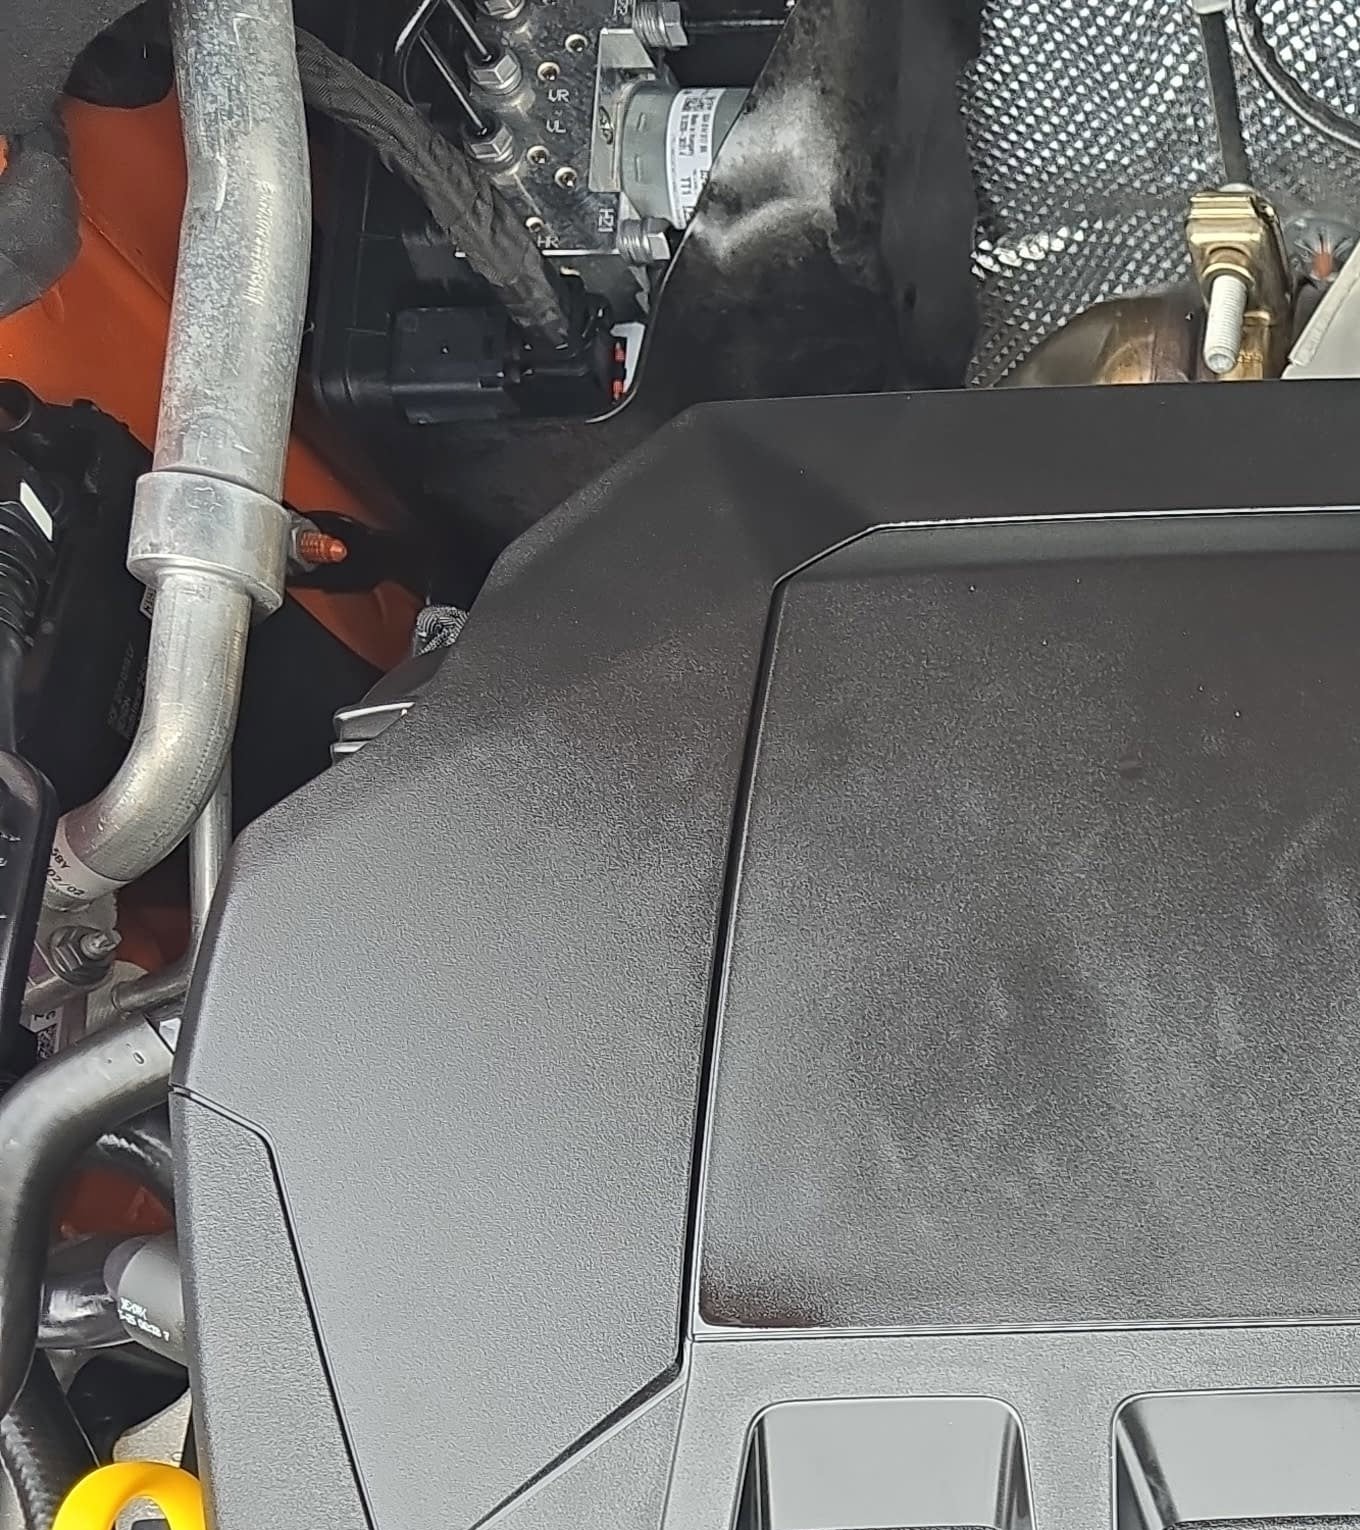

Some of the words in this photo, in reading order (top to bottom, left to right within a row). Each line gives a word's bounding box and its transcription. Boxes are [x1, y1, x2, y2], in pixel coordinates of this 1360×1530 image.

[548, 89, 570, 102] VR
[546, 120, 567, 133] VL
[537, 235, 560, 249] HR
